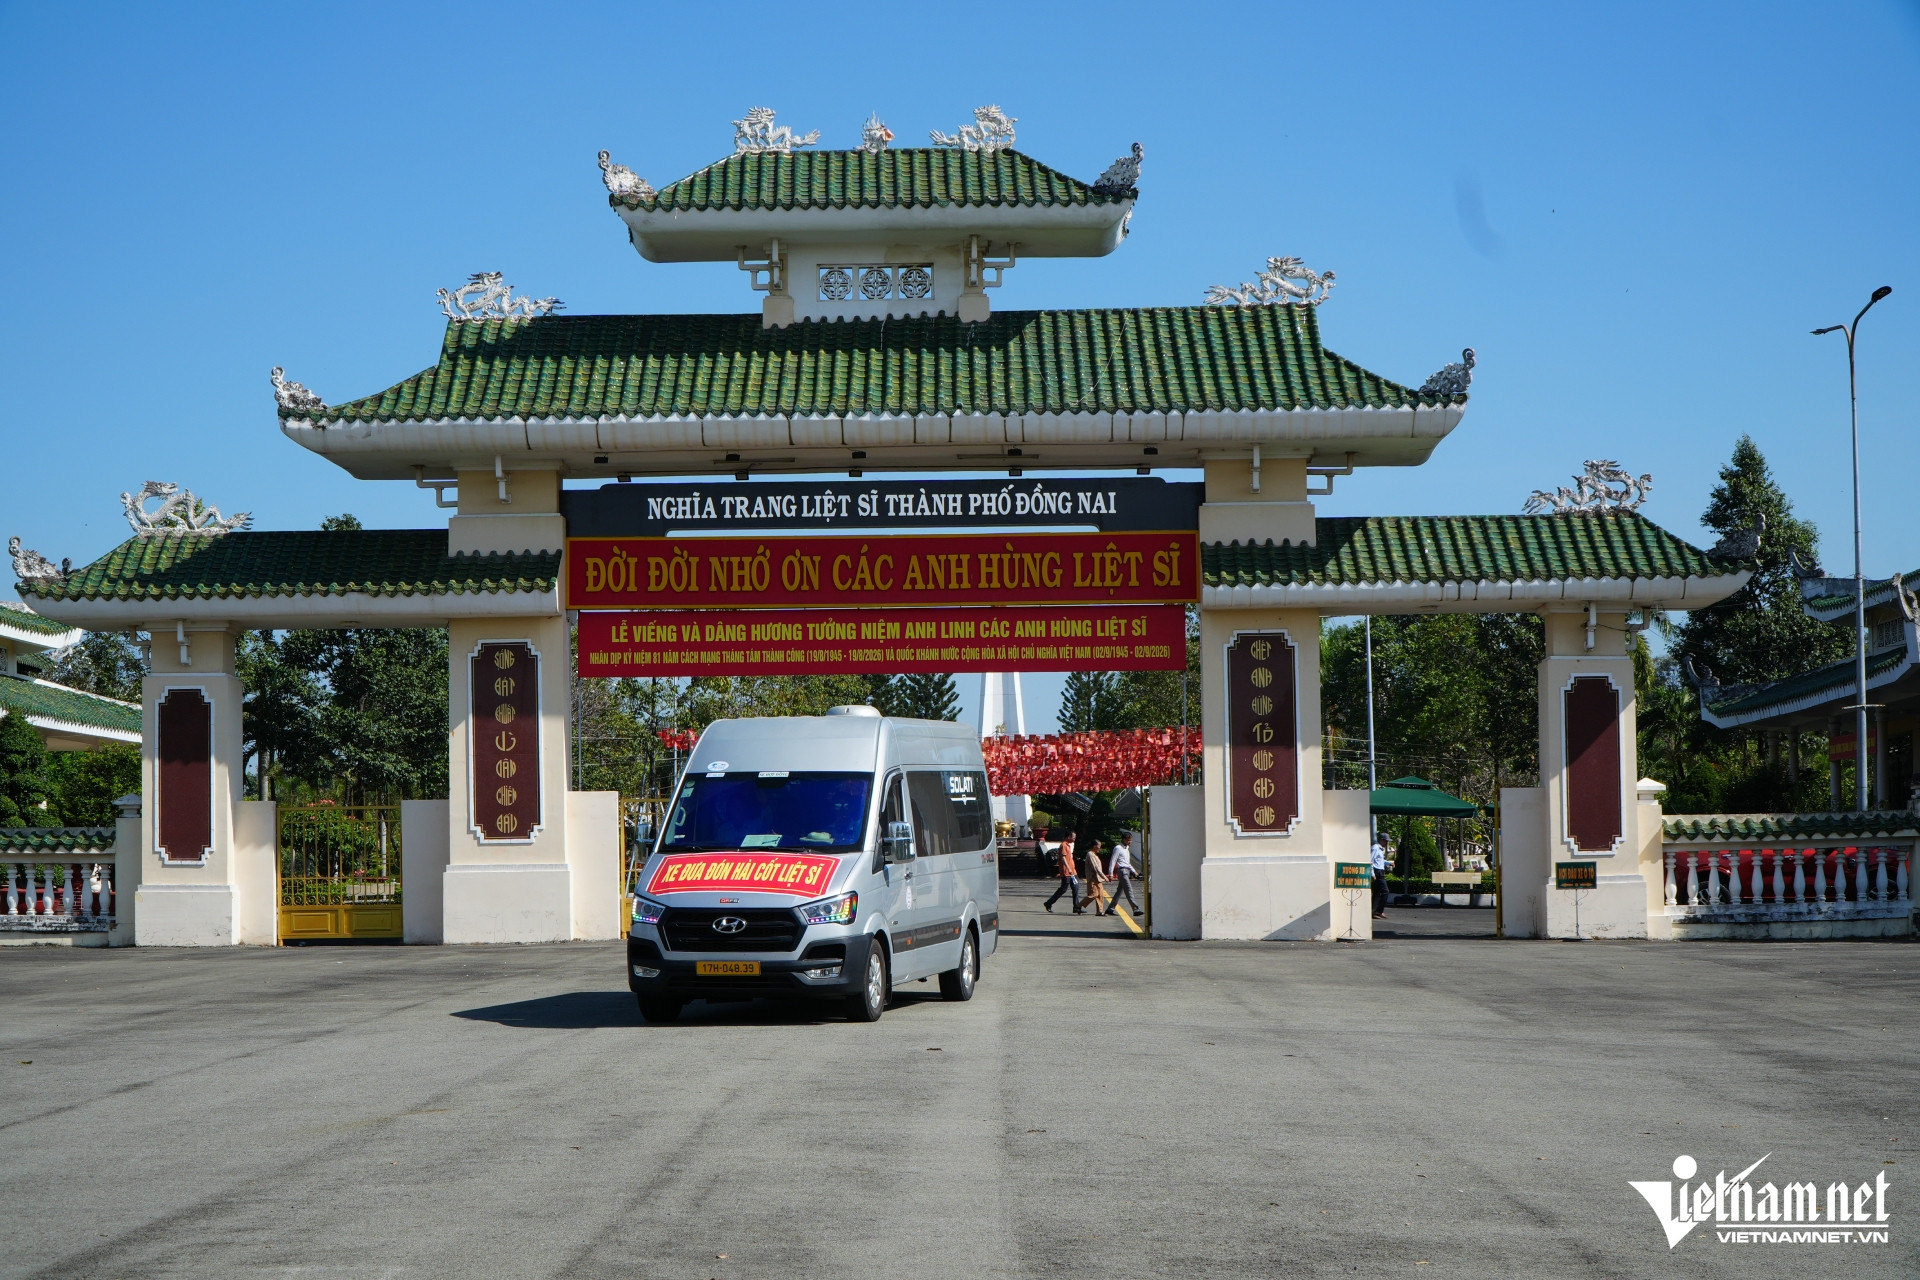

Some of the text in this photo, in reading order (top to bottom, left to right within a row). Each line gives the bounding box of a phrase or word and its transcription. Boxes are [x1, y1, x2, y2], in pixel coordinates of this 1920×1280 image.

[647, 482, 1116, 523] NGHĨA TRANG LIỆT SĨ THÀNH PHỐ ĐỒNG NAI
[585, 541, 1180, 596] ĐỜI ĐỜI NHỚ ƠN CÁC ANH HÙNG LIỆT SĨ
[611, 615, 1147, 643] LỄ VIẾNG VÀ DÂNG HƯƠNG TƯỞNG NIỆM ANH LINH CÁC ANH HÙNG LIỆT SĨ
[634, 649, 652, 666] NIỆM
[680, 648, 699, 664] CÁCH
[700, 651, 720, 666] MẠNG
[722, 648, 745, 663] THÁNG
[746, 648, 760, 662] TÁM
[762, 648, 785, 662] THÀNH
[786, 648, 805, 662] CÔNG
[806, 649, 842, 663] (19/8/1945
[886, 646, 895, 661] VÀ
[896, 644, 915, 662] QUỐC
[916, 646, 939, 660] KHÁNH
[941, 645, 960, 660] NƯỚC
[961, 645, 980, 662] CỘNG
[996, 644, 1006, 660] XÃ
[1008, 644, 1020, 662] HỘI
[1021, 642, 1035, 659] CHỦ
[1036, 644, 1058, 659] NGHĨA
[1059, 644, 1073, 661] VIỆT
[1075, 646, 1091, 659] NAM
[1092, 645, 1129, 659] (02/9/1945
[1134, 645, 1170, 659] 02/9/2026)
[1251, 667, 1273, 688] ANH
[1251, 694, 1273, 716] HÙNG
[949, 776, 974, 793] SOLATI
[1253, 804, 1276, 827] CÔNG
[661, 864, 683, 883] XE
[678, 861, 706, 882] ĐƯA
[704, 860, 734, 881] ĐÓN
[753, 858, 778, 882] CỐT
[777, 861, 806, 887] LIỆT
[804, 864, 825, 885] SĨ
[702, 963, 754, 973] 17H-048.39
